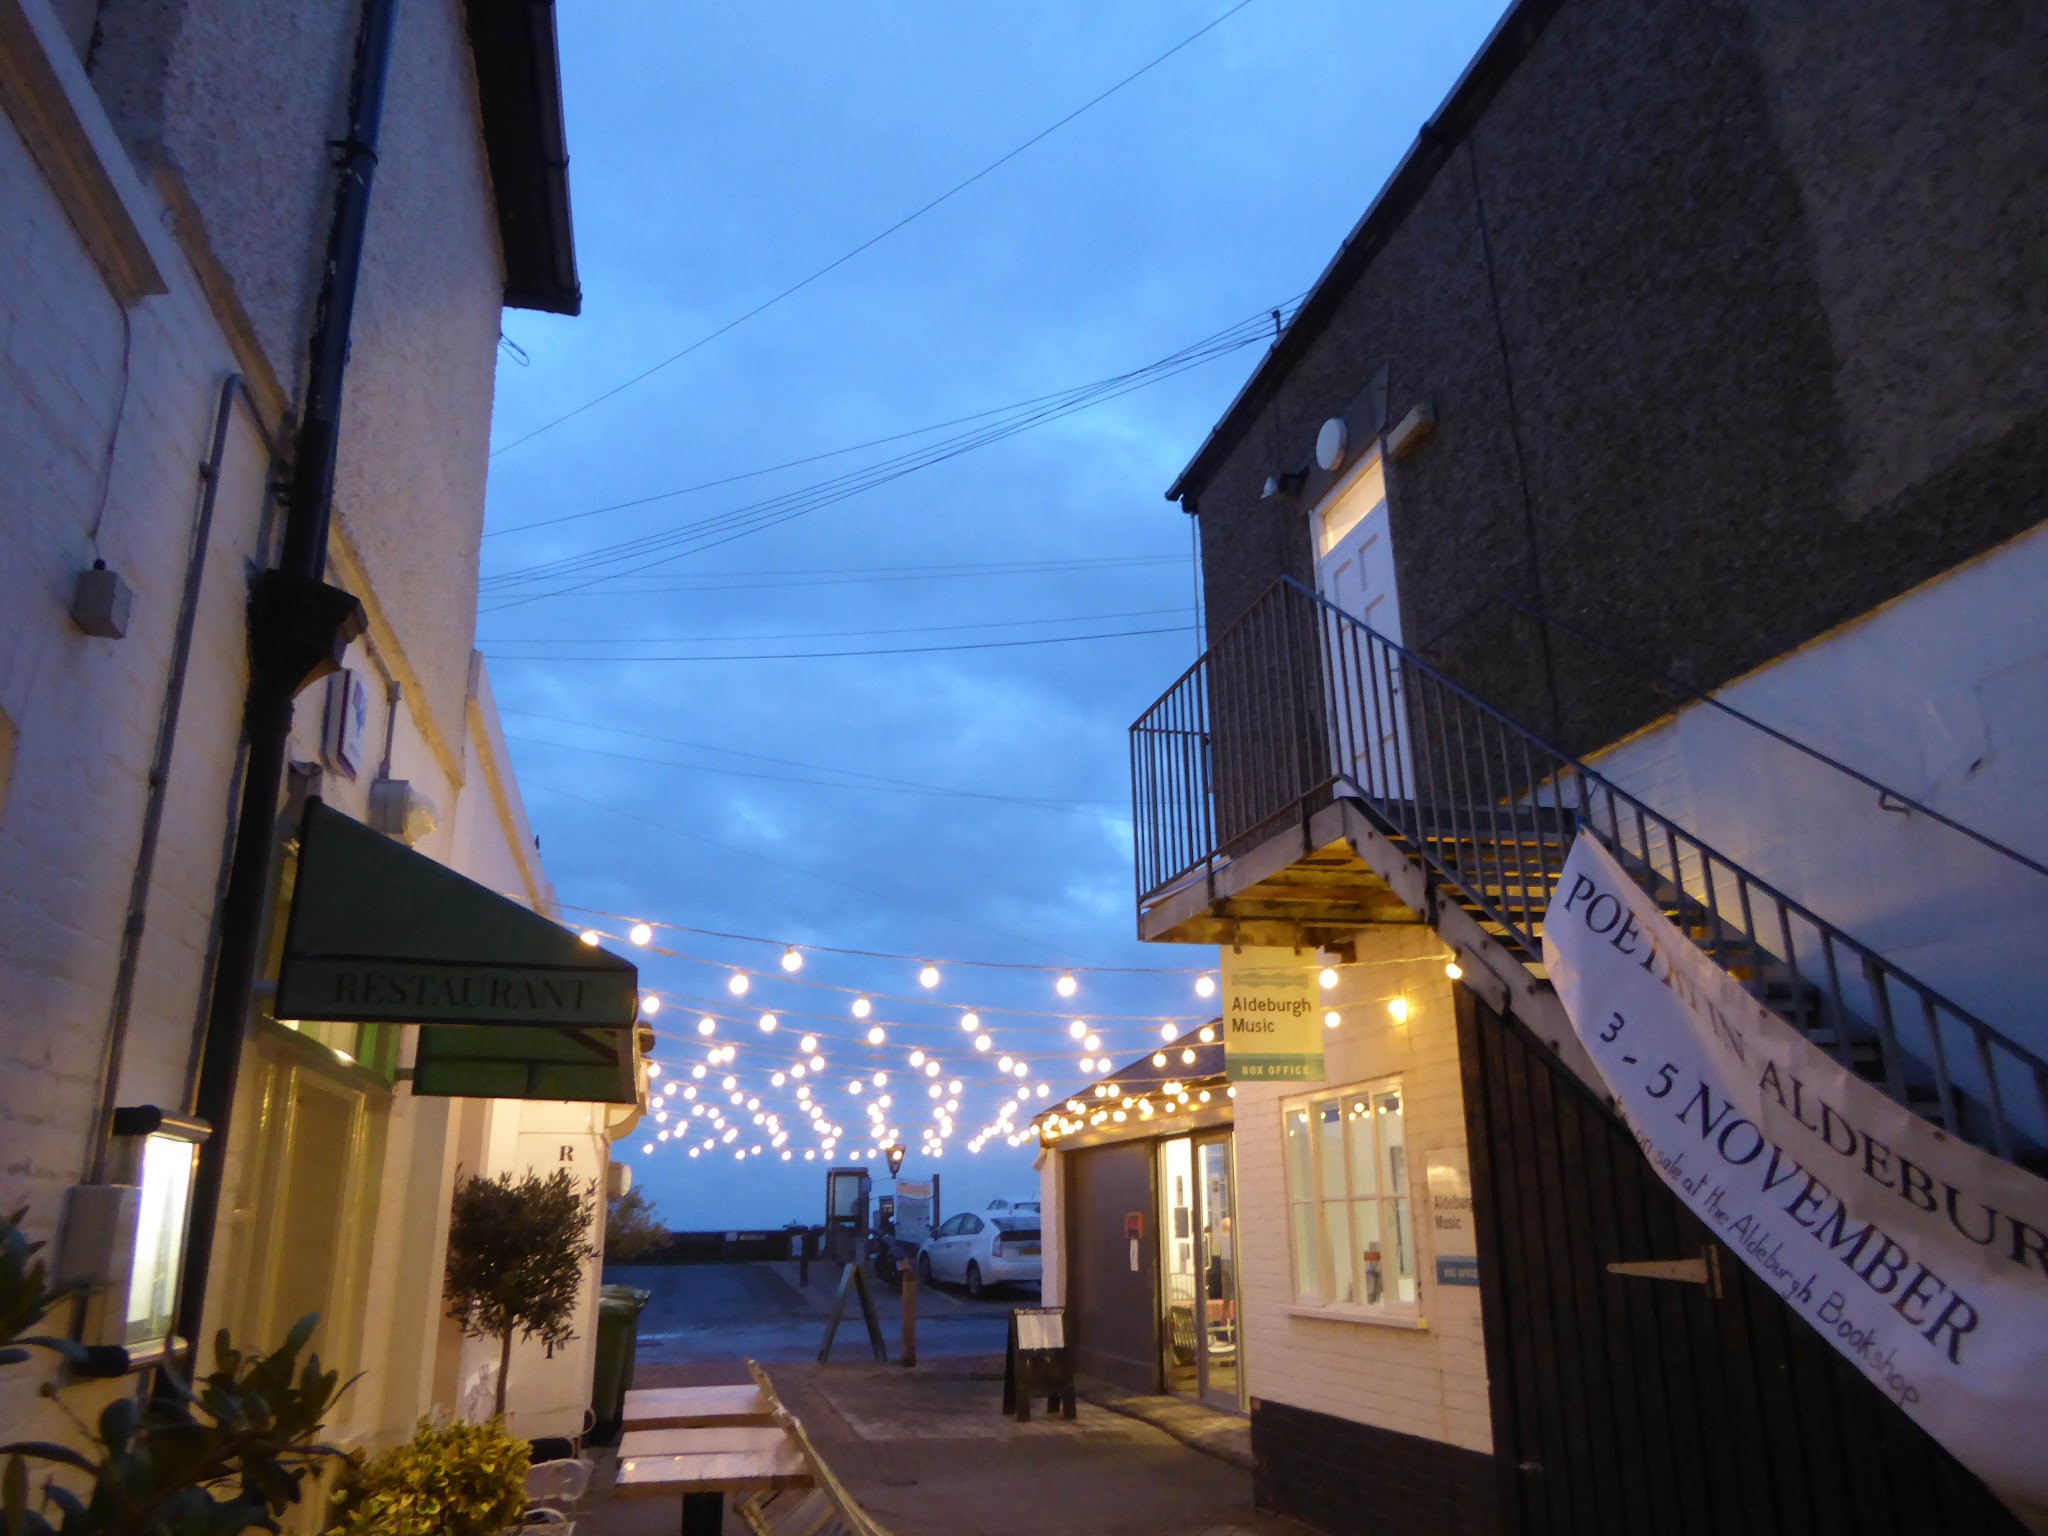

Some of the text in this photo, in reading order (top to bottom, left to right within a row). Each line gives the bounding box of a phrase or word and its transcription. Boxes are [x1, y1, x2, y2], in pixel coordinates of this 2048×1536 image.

[1564, 872, 1699, 1013] POET
[335, 971, 593, 1011] RESTAURANT
[1231, 996, 1312, 1018] Aldeburgh
[1231, 1018, 1276, 1034] Music
[1241, 1064, 1311, 1076] BOX OFFICE
[1599, 1011, 1626, 1044] 3
[1645, 1062, 1680, 1099] 5
[1674, 1080, 1981, 1366] NOVEMBER
[1435, 1214, 1462, 1231] Music
[1653, 1151, 1685, 1182] sale
[1681, 1172, 1709, 1197] at
[1702, 1184, 1730, 1227] the
[1726, 1213, 1818, 1305] Aldeburgh
[1816, 1288, 1920, 1408] Bookshop
